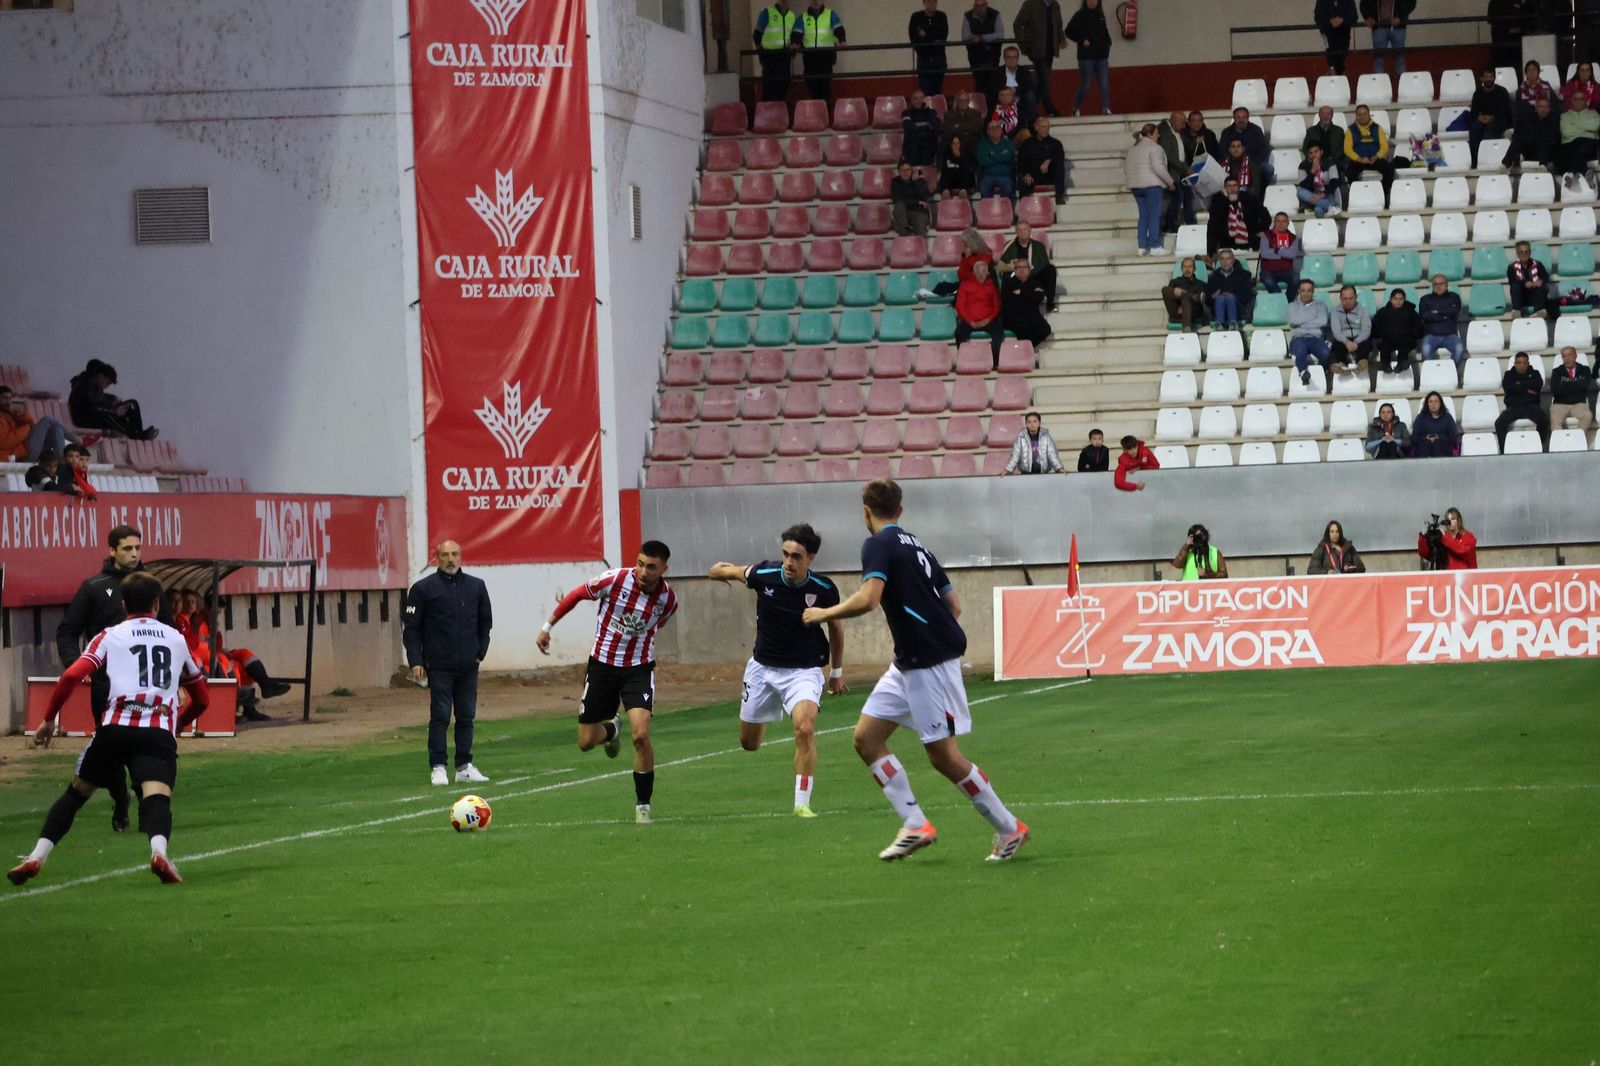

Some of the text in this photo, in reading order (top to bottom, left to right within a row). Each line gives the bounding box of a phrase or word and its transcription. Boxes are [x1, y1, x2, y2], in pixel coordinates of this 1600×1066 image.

[426, 42, 573, 68] CAJA RURAL
[453, 72, 547, 87] DE ZAMORA
[434, 254, 580, 280] CAJA RURAL
[461, 283, 555, 298] DE ZAMORA
[442, 464, 587, 492] CAJA RURAL
[468, 494, 563, 510] DE ZAMORA
[136, 505, 182, 546] STAND
[131, 628, 166, 639] FARRELL
[1122, 628, 1325, 670] ZAMORA
[129, 644, 172, 690] 18
